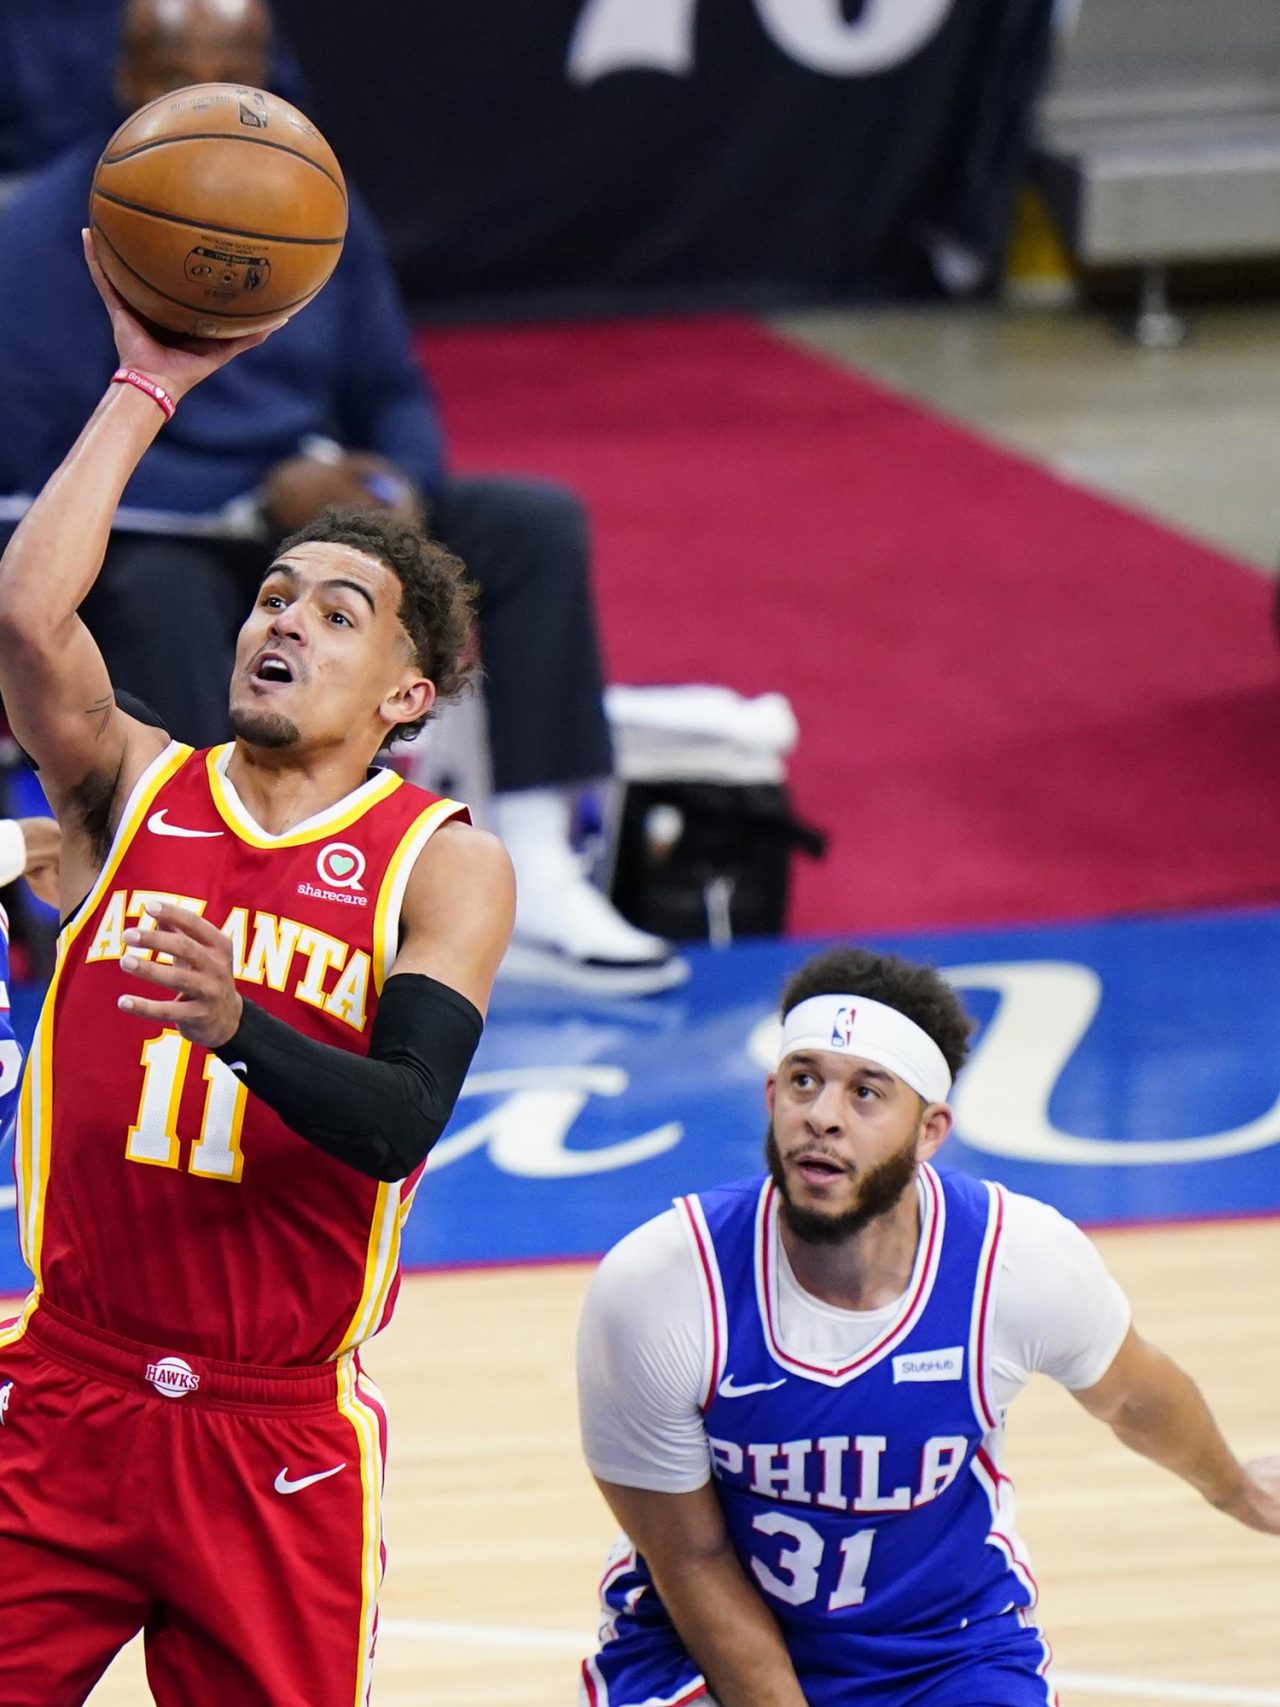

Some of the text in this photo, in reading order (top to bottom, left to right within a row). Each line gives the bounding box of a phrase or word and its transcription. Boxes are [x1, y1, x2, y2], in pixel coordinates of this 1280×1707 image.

[127, 371, 156, 391] Bryant
[297, 882, 368, 906] sharecare
[125, 1028, 249, 1183] 11
[147, 1366, 198, 1389] HAWKS
[901, 1360, 954, 1374] StubHub
[706, 1435, 969, 1514] PHILA
[750, 1511, 877, 1612] 31
